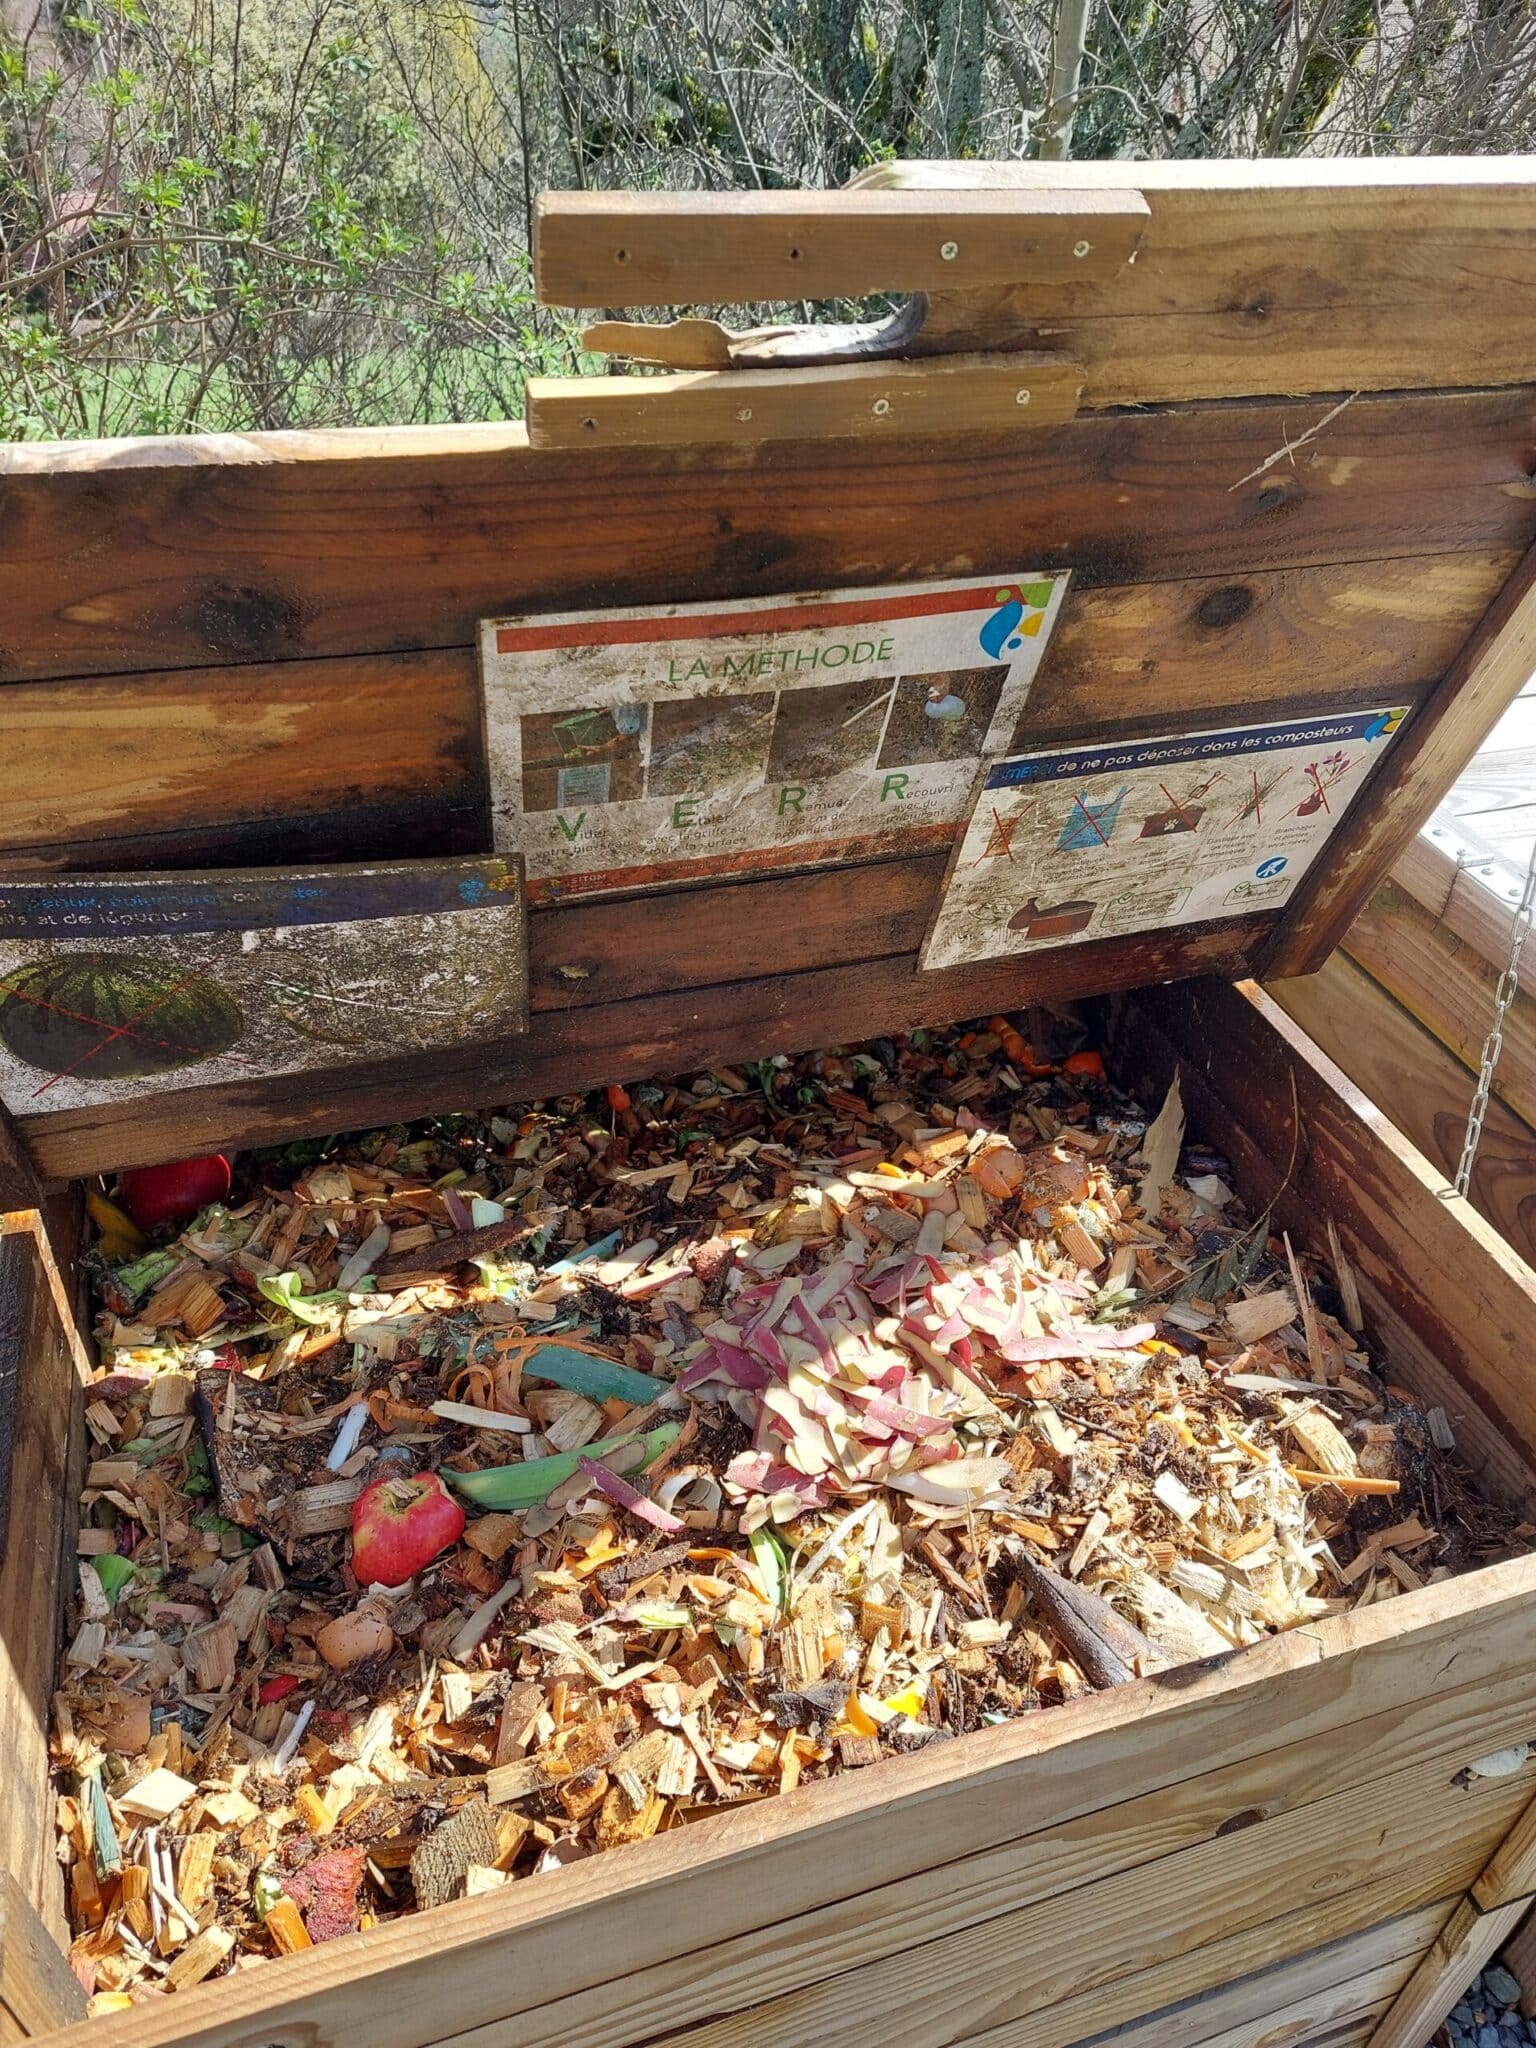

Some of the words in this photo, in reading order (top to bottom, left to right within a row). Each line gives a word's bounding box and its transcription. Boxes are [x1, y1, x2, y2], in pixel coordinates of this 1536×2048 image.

[668, 657, 709, 682] LA
[1056, 761, 1078, 773] de
[1081, 758, 1101, 770] ne
[1104, 754, 1133, 769] pas
[1137, 744, 1200, 762] déposer
[1202, 739, 1238, 753] dans
[1241, 736, 1262, 748] les
[1265, 723, 1355, 746] composteurs
